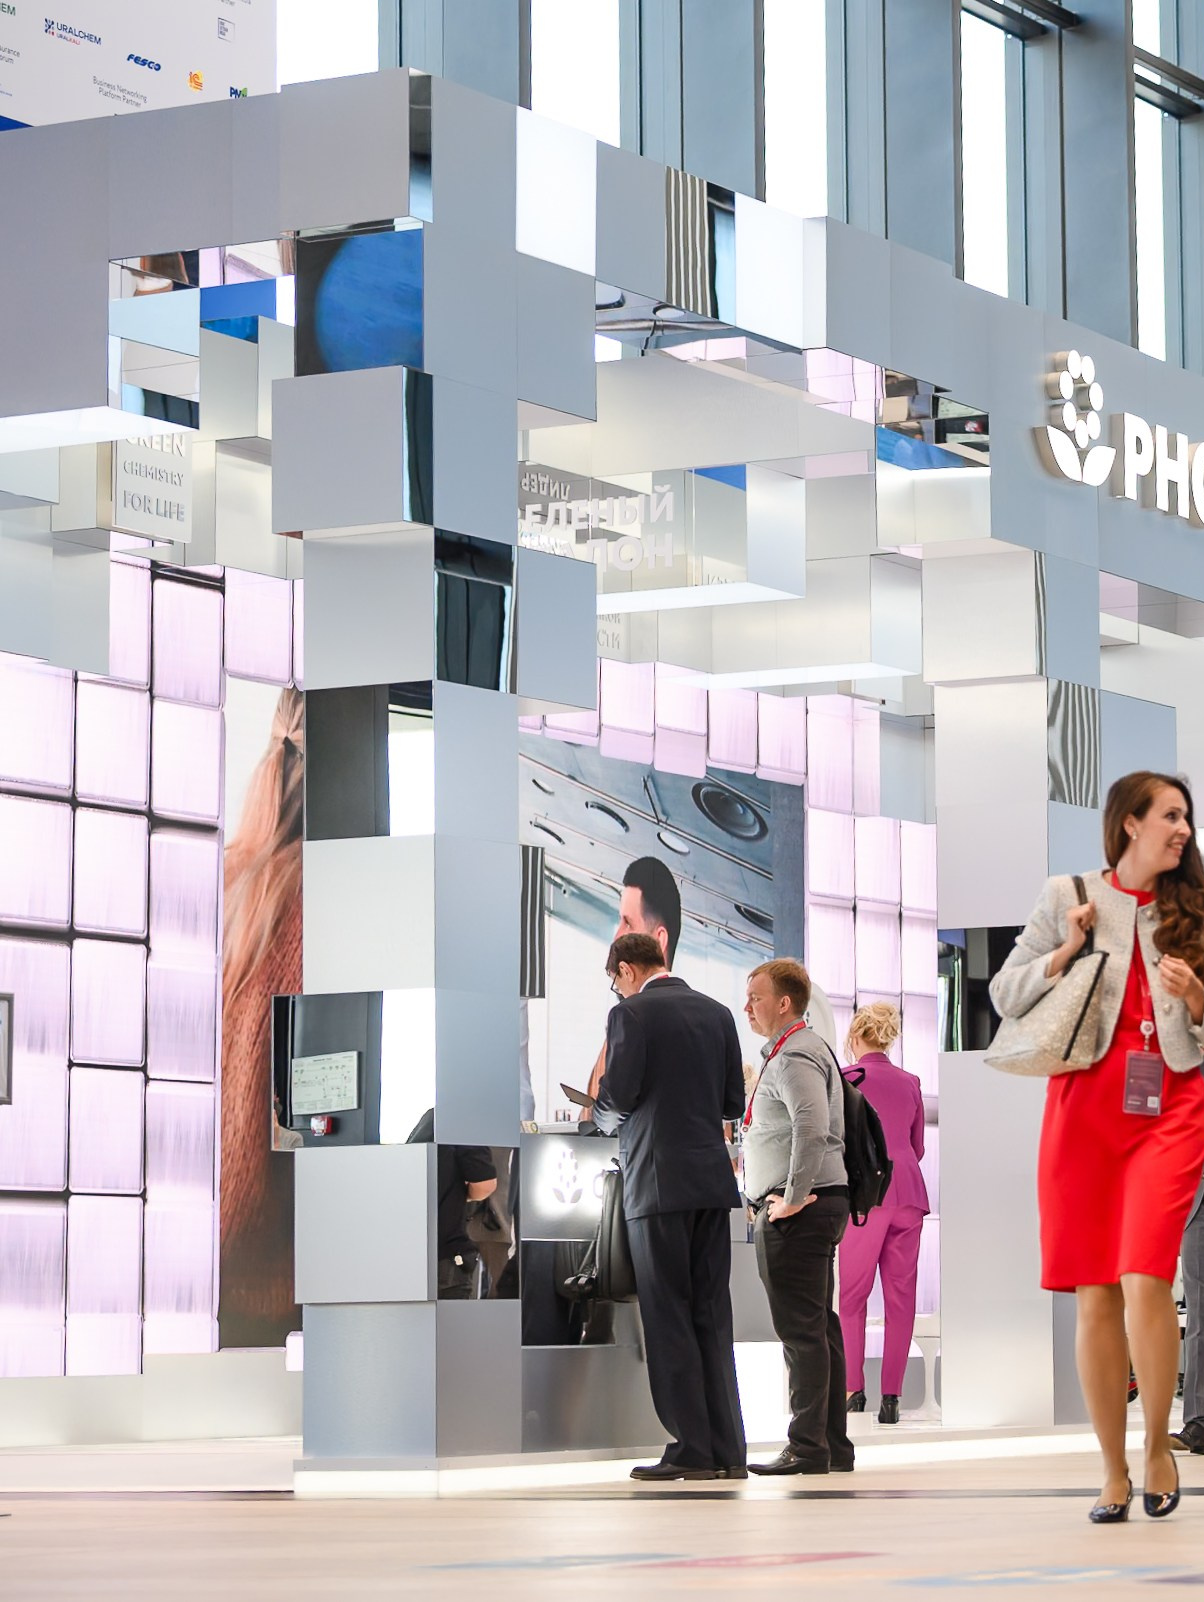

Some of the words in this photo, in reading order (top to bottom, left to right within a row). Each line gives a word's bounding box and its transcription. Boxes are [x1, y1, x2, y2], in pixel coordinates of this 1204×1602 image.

[56, 22, 102, 45] URALCHEM
[127, 54, 161, 71] FESCO
[124, 460, 184, 487] CHEMISTRY
[123, 490, 153, 515] FOR
[156, 498, 185, 522] LIFE
[518, 484, 674, 532] ЕЛЕНЫЙ
